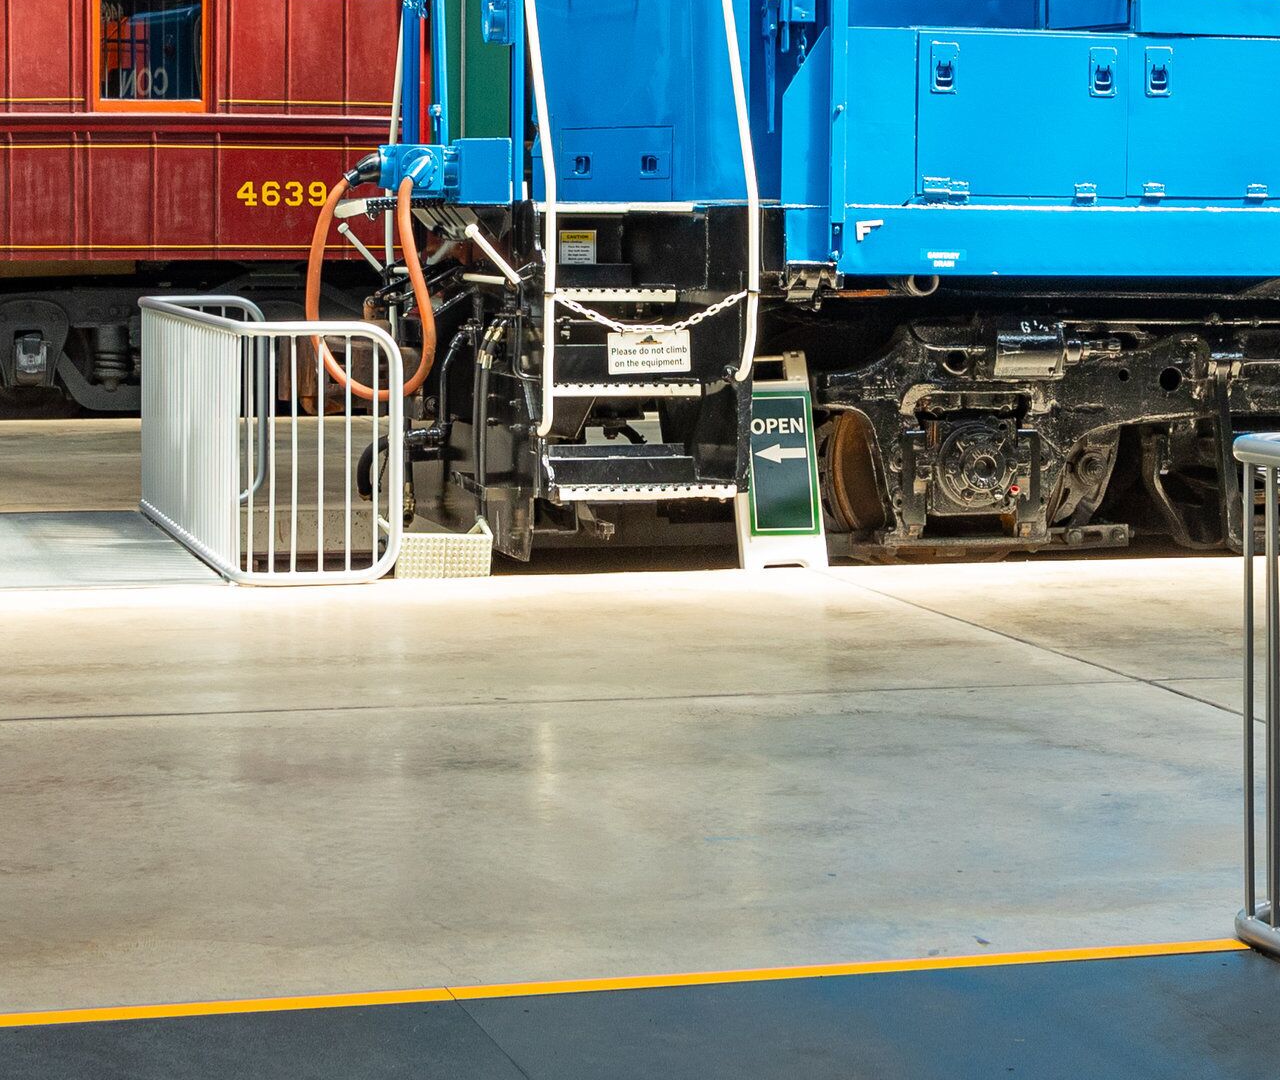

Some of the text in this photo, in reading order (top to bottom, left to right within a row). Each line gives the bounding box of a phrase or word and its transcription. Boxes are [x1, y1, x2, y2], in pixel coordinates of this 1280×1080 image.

[236, 181, 327, 206] 4639
[856, 219, 884, 241] F
[611, 347, 637, 356] Please
[639, 347, 649, 355] do
[666, 346, 687, 354] climb
[627, 359, 639, 367] the
[641, 358, 685, 369] equipment.
[750, 417, 804, 435] OPEN
